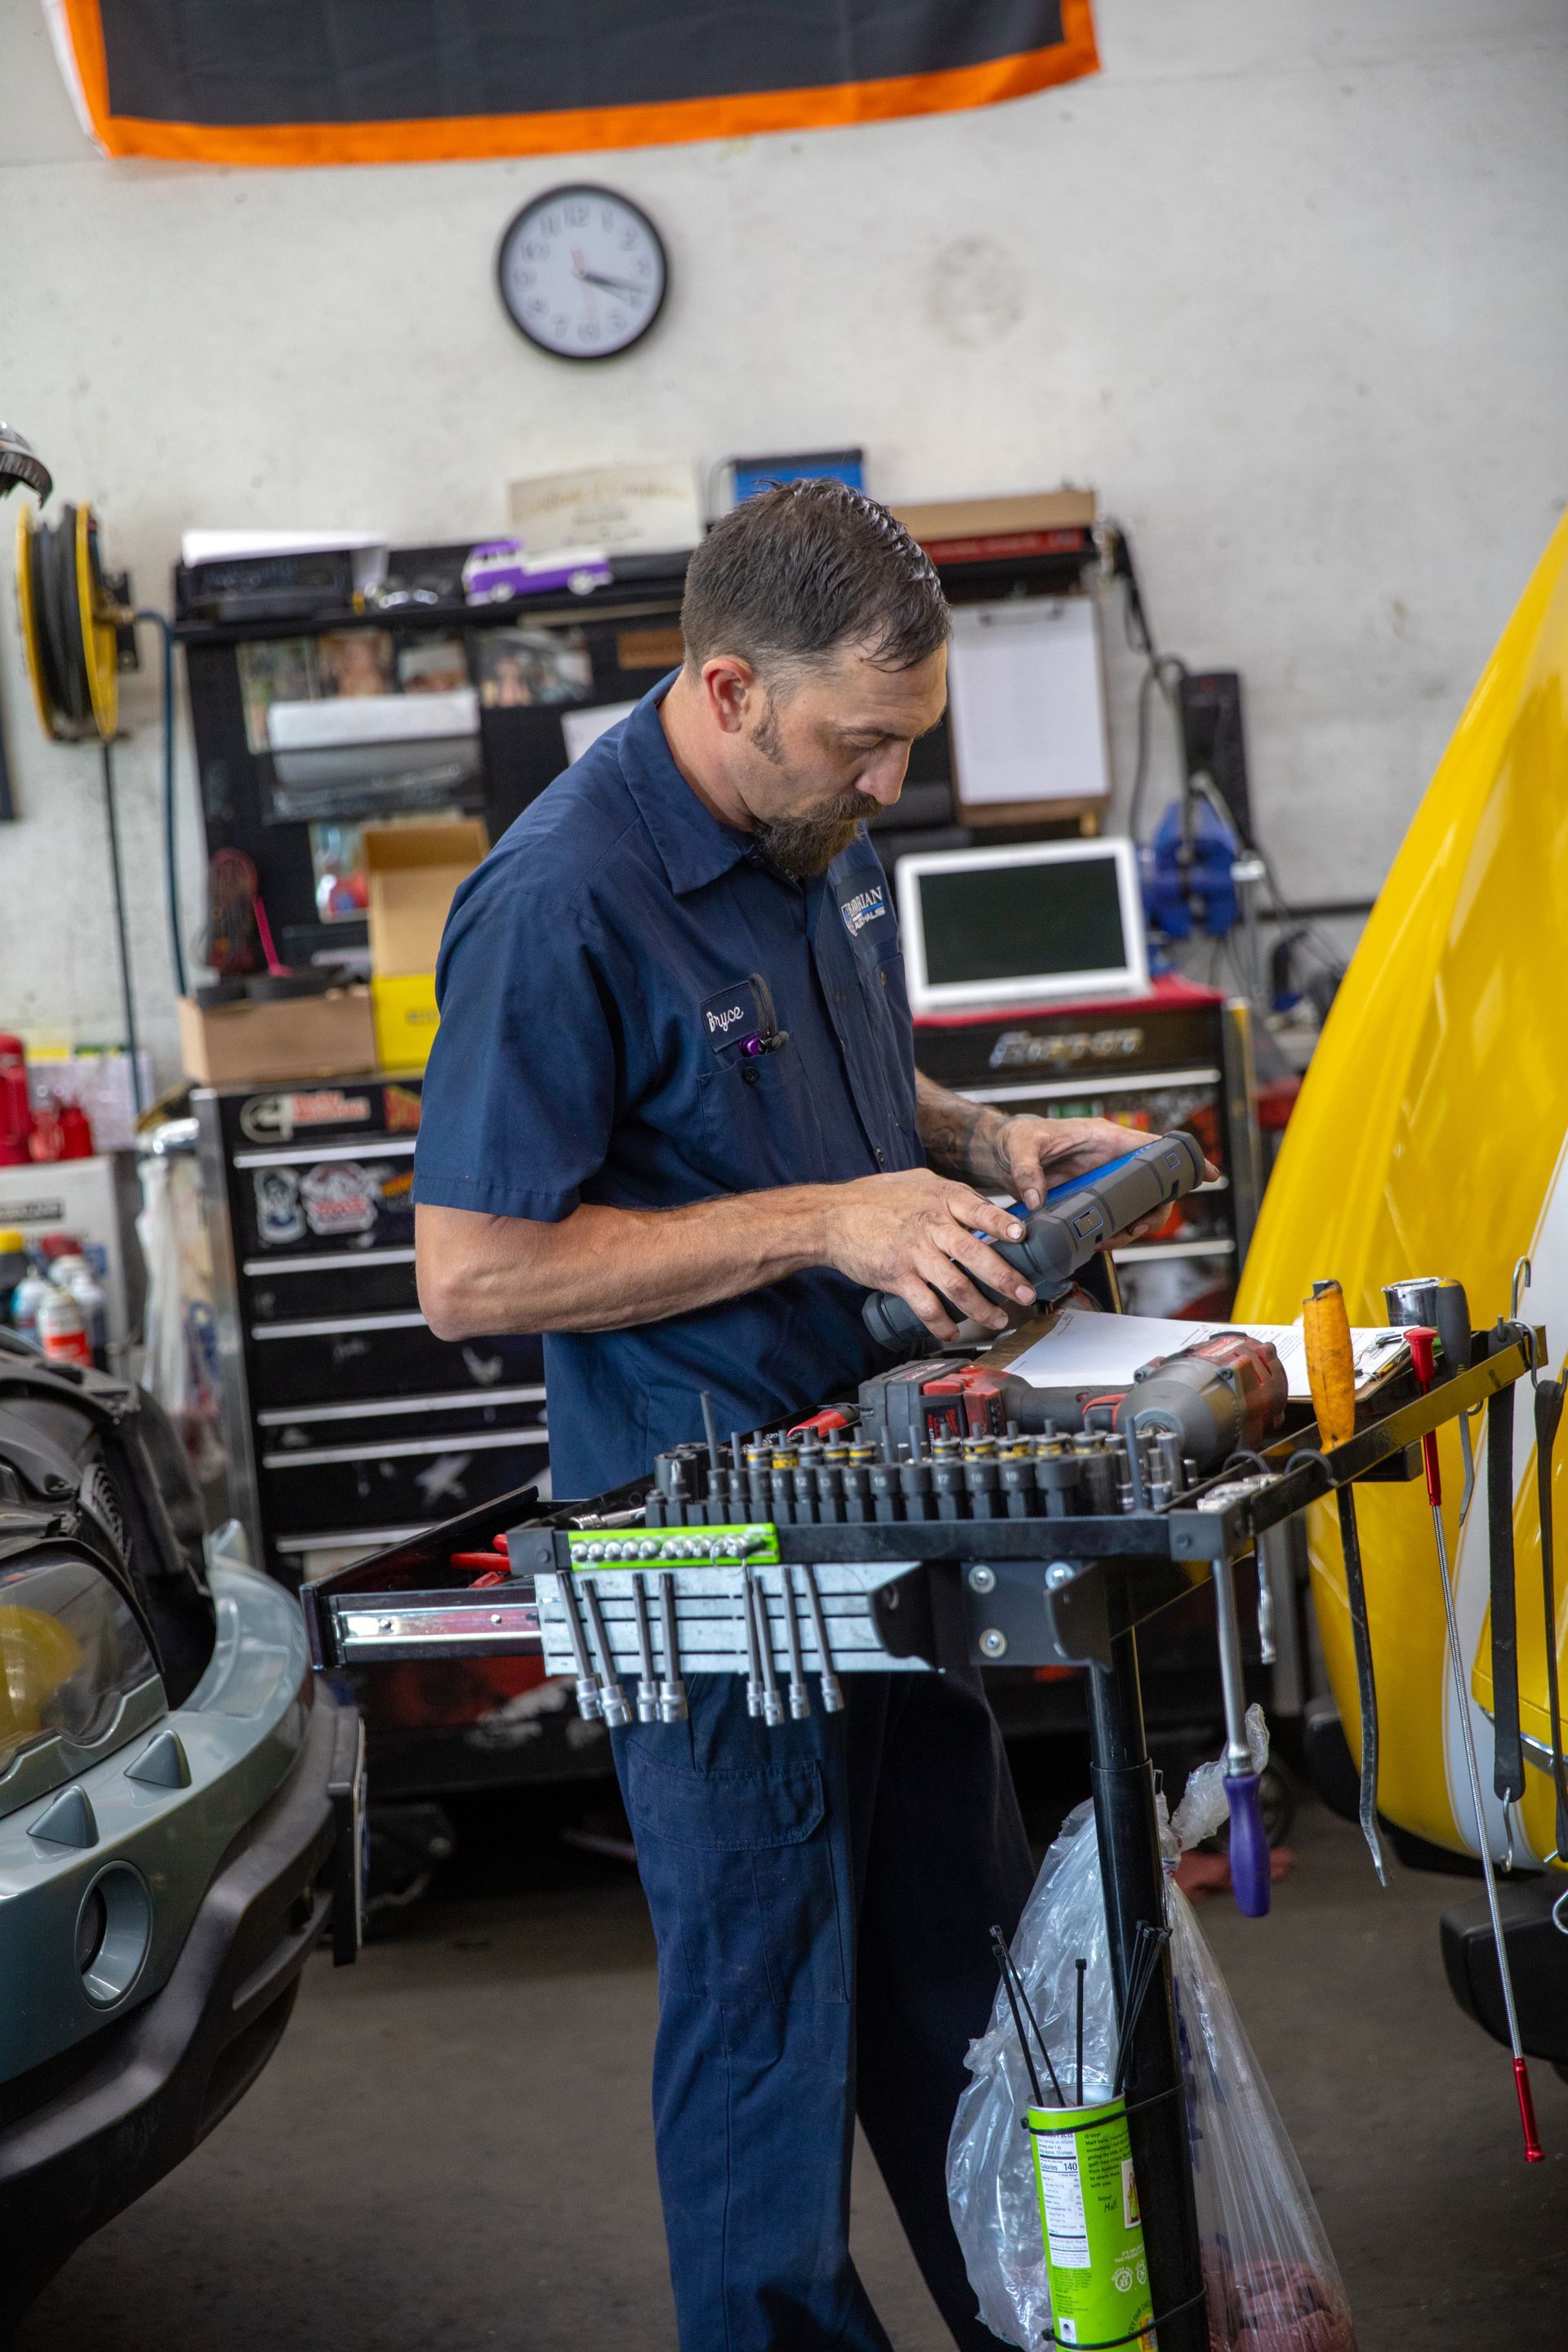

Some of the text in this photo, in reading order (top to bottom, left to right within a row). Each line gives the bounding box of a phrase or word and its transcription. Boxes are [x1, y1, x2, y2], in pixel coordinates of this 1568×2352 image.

[706, 1006, 744, 1032] Bryce
[795, 1477, 807, 1486] 12
[937, 1473, 949, 1485] 17
[1064, 2163, 1078, 2172] 140
